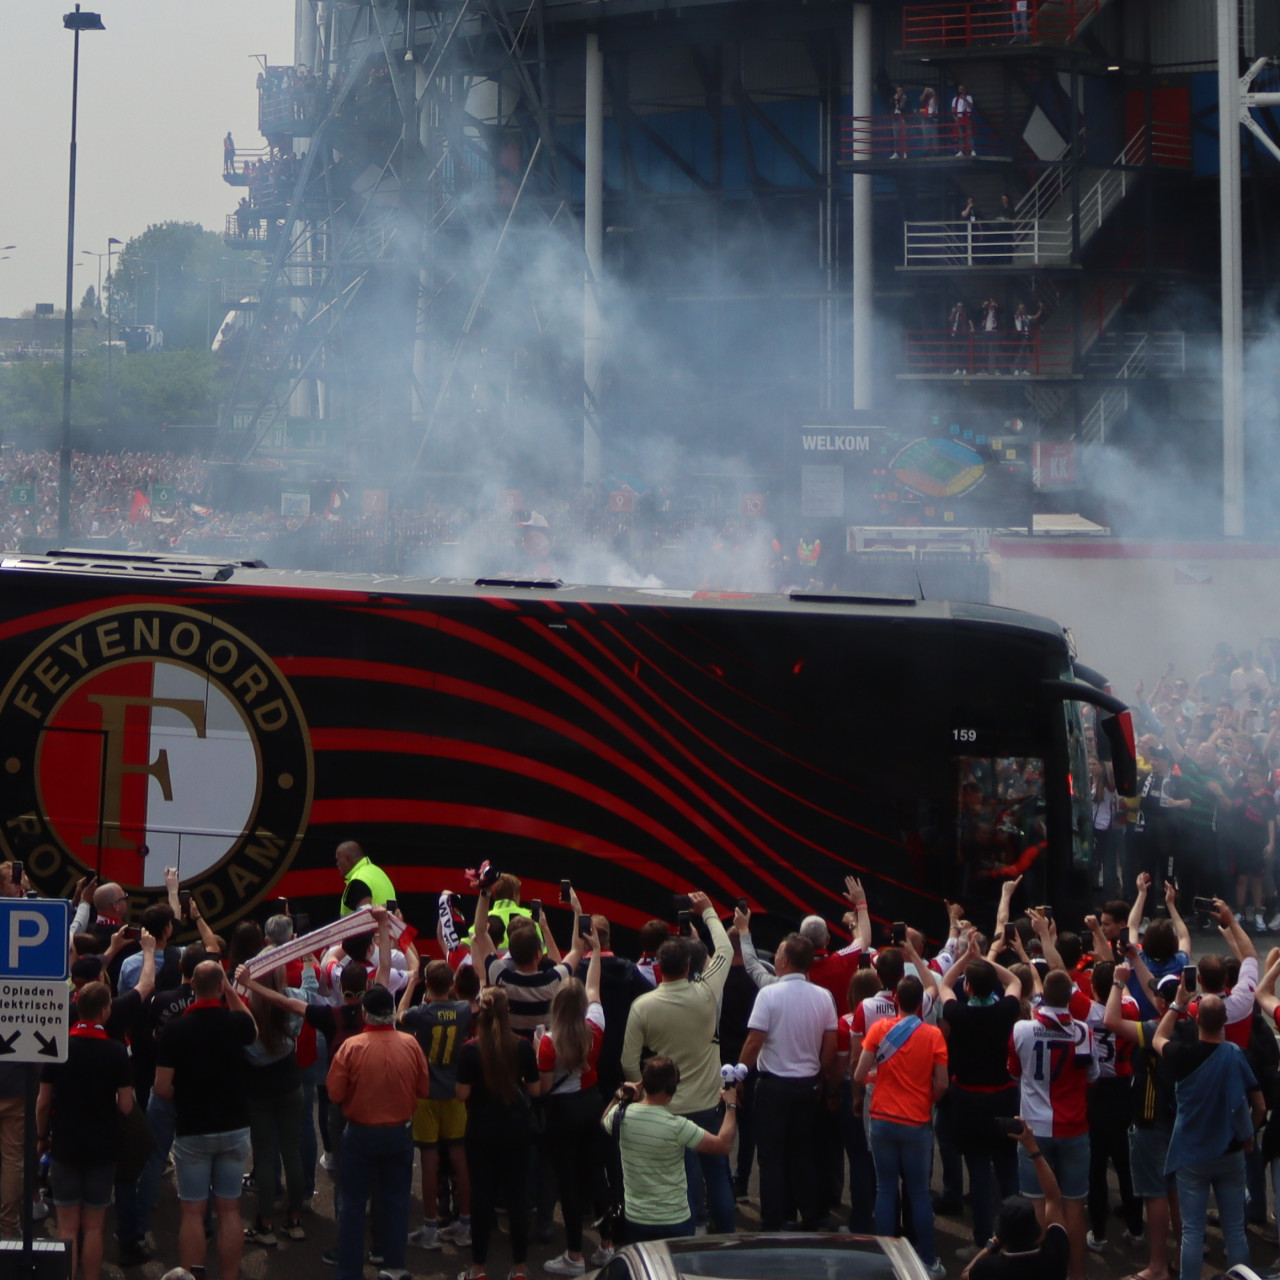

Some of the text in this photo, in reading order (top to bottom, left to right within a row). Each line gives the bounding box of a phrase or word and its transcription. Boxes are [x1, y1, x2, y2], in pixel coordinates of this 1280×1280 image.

[803, 435, 870, 451] WELKOM
[13, 617, 289, 732] FEYENOORD
[952, 729, 977, 741] 159
[7, 810, 287, 922] ROTEDAM
[8, 910, 49, 969] P
[2, 985, 54, 997] Opladen
[429, 1025, 457, 1065] 11
[1033, 1040, 1068, 1081] 17
